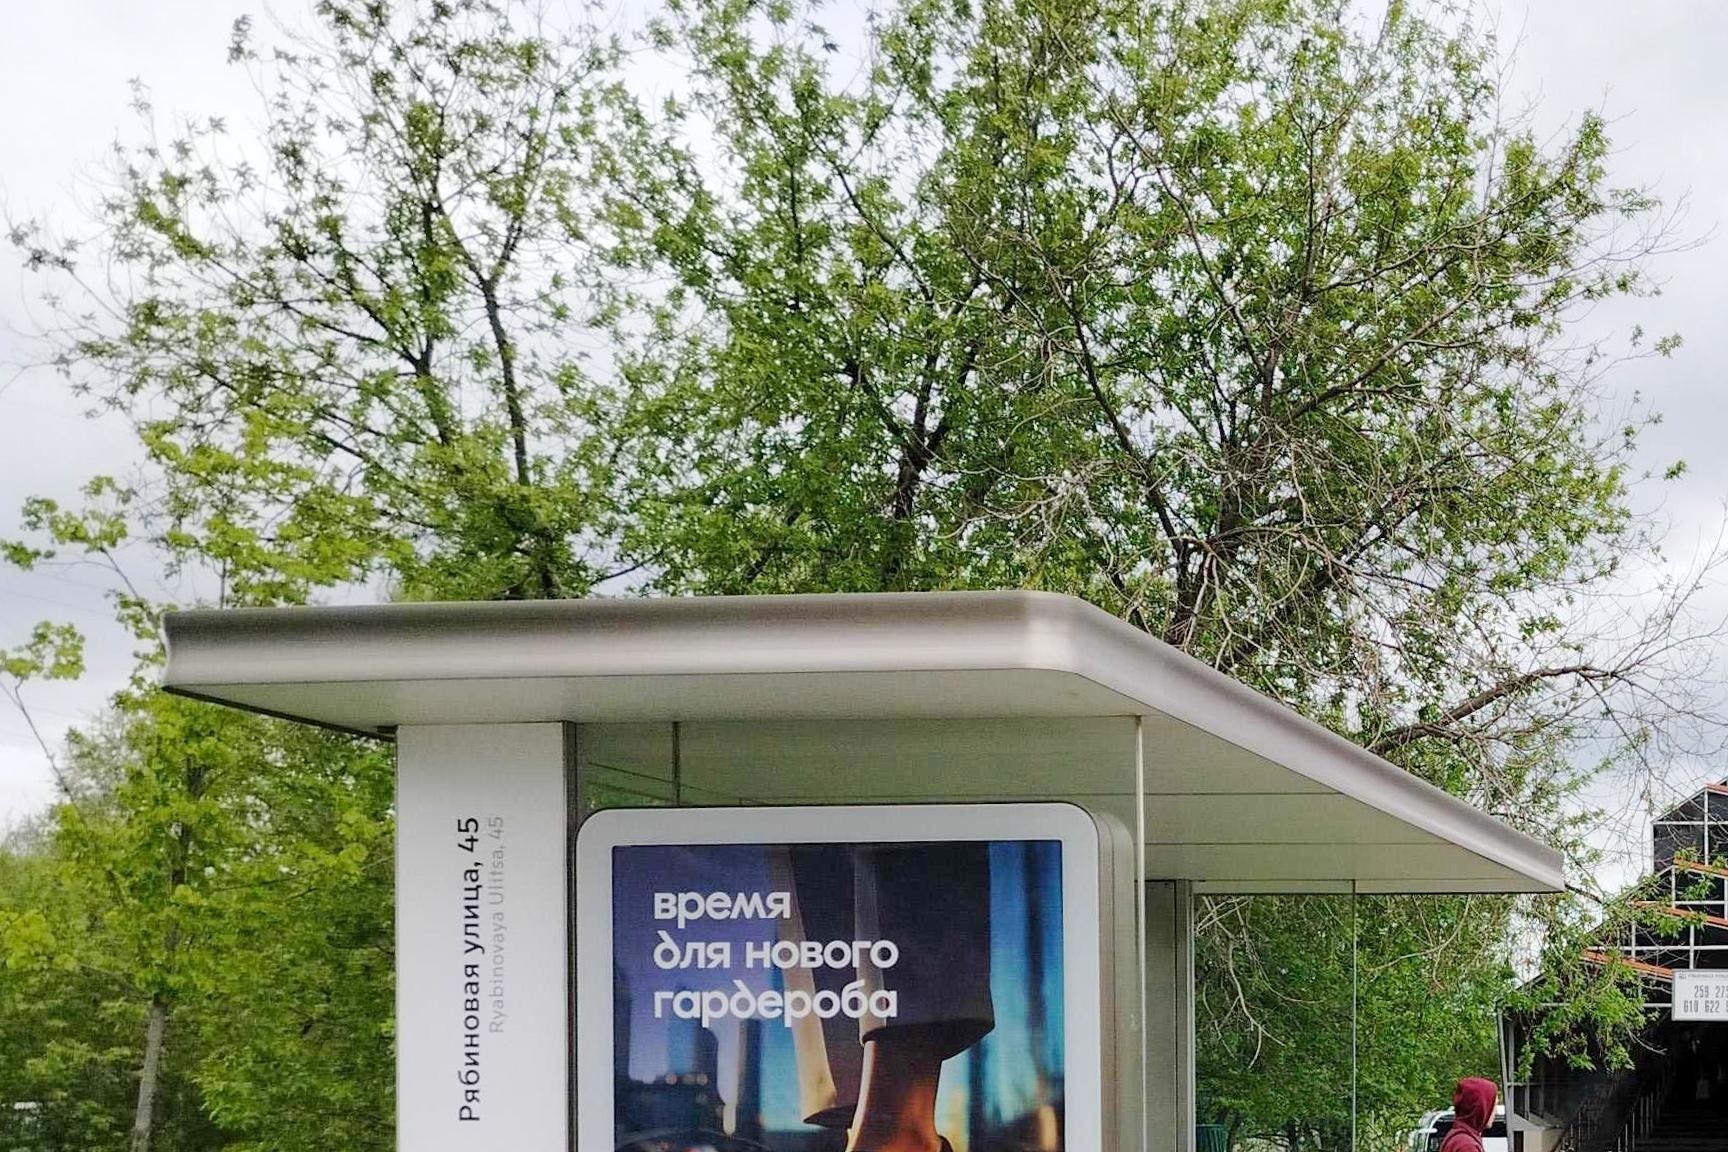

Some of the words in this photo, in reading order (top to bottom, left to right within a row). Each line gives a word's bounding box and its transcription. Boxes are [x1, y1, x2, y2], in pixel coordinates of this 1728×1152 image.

[457, 817, 479, 853] 45
[488, 816, 504, 840] 45
[489, 846, 506, 905] Ulitsa,
[461, 860, 485, 954] улица,
[654, 891, 791, 929] время
[653, 930, 731, 969] для
[746, 940, 899, 969] нового
[489, 912, 508, 1033] Ryabinovaya
[654, 980, 898, 1028] гардероба
[1705, 1000, 1720, 1013] 622
[458, 963, 480, 1121] Рябиновая
